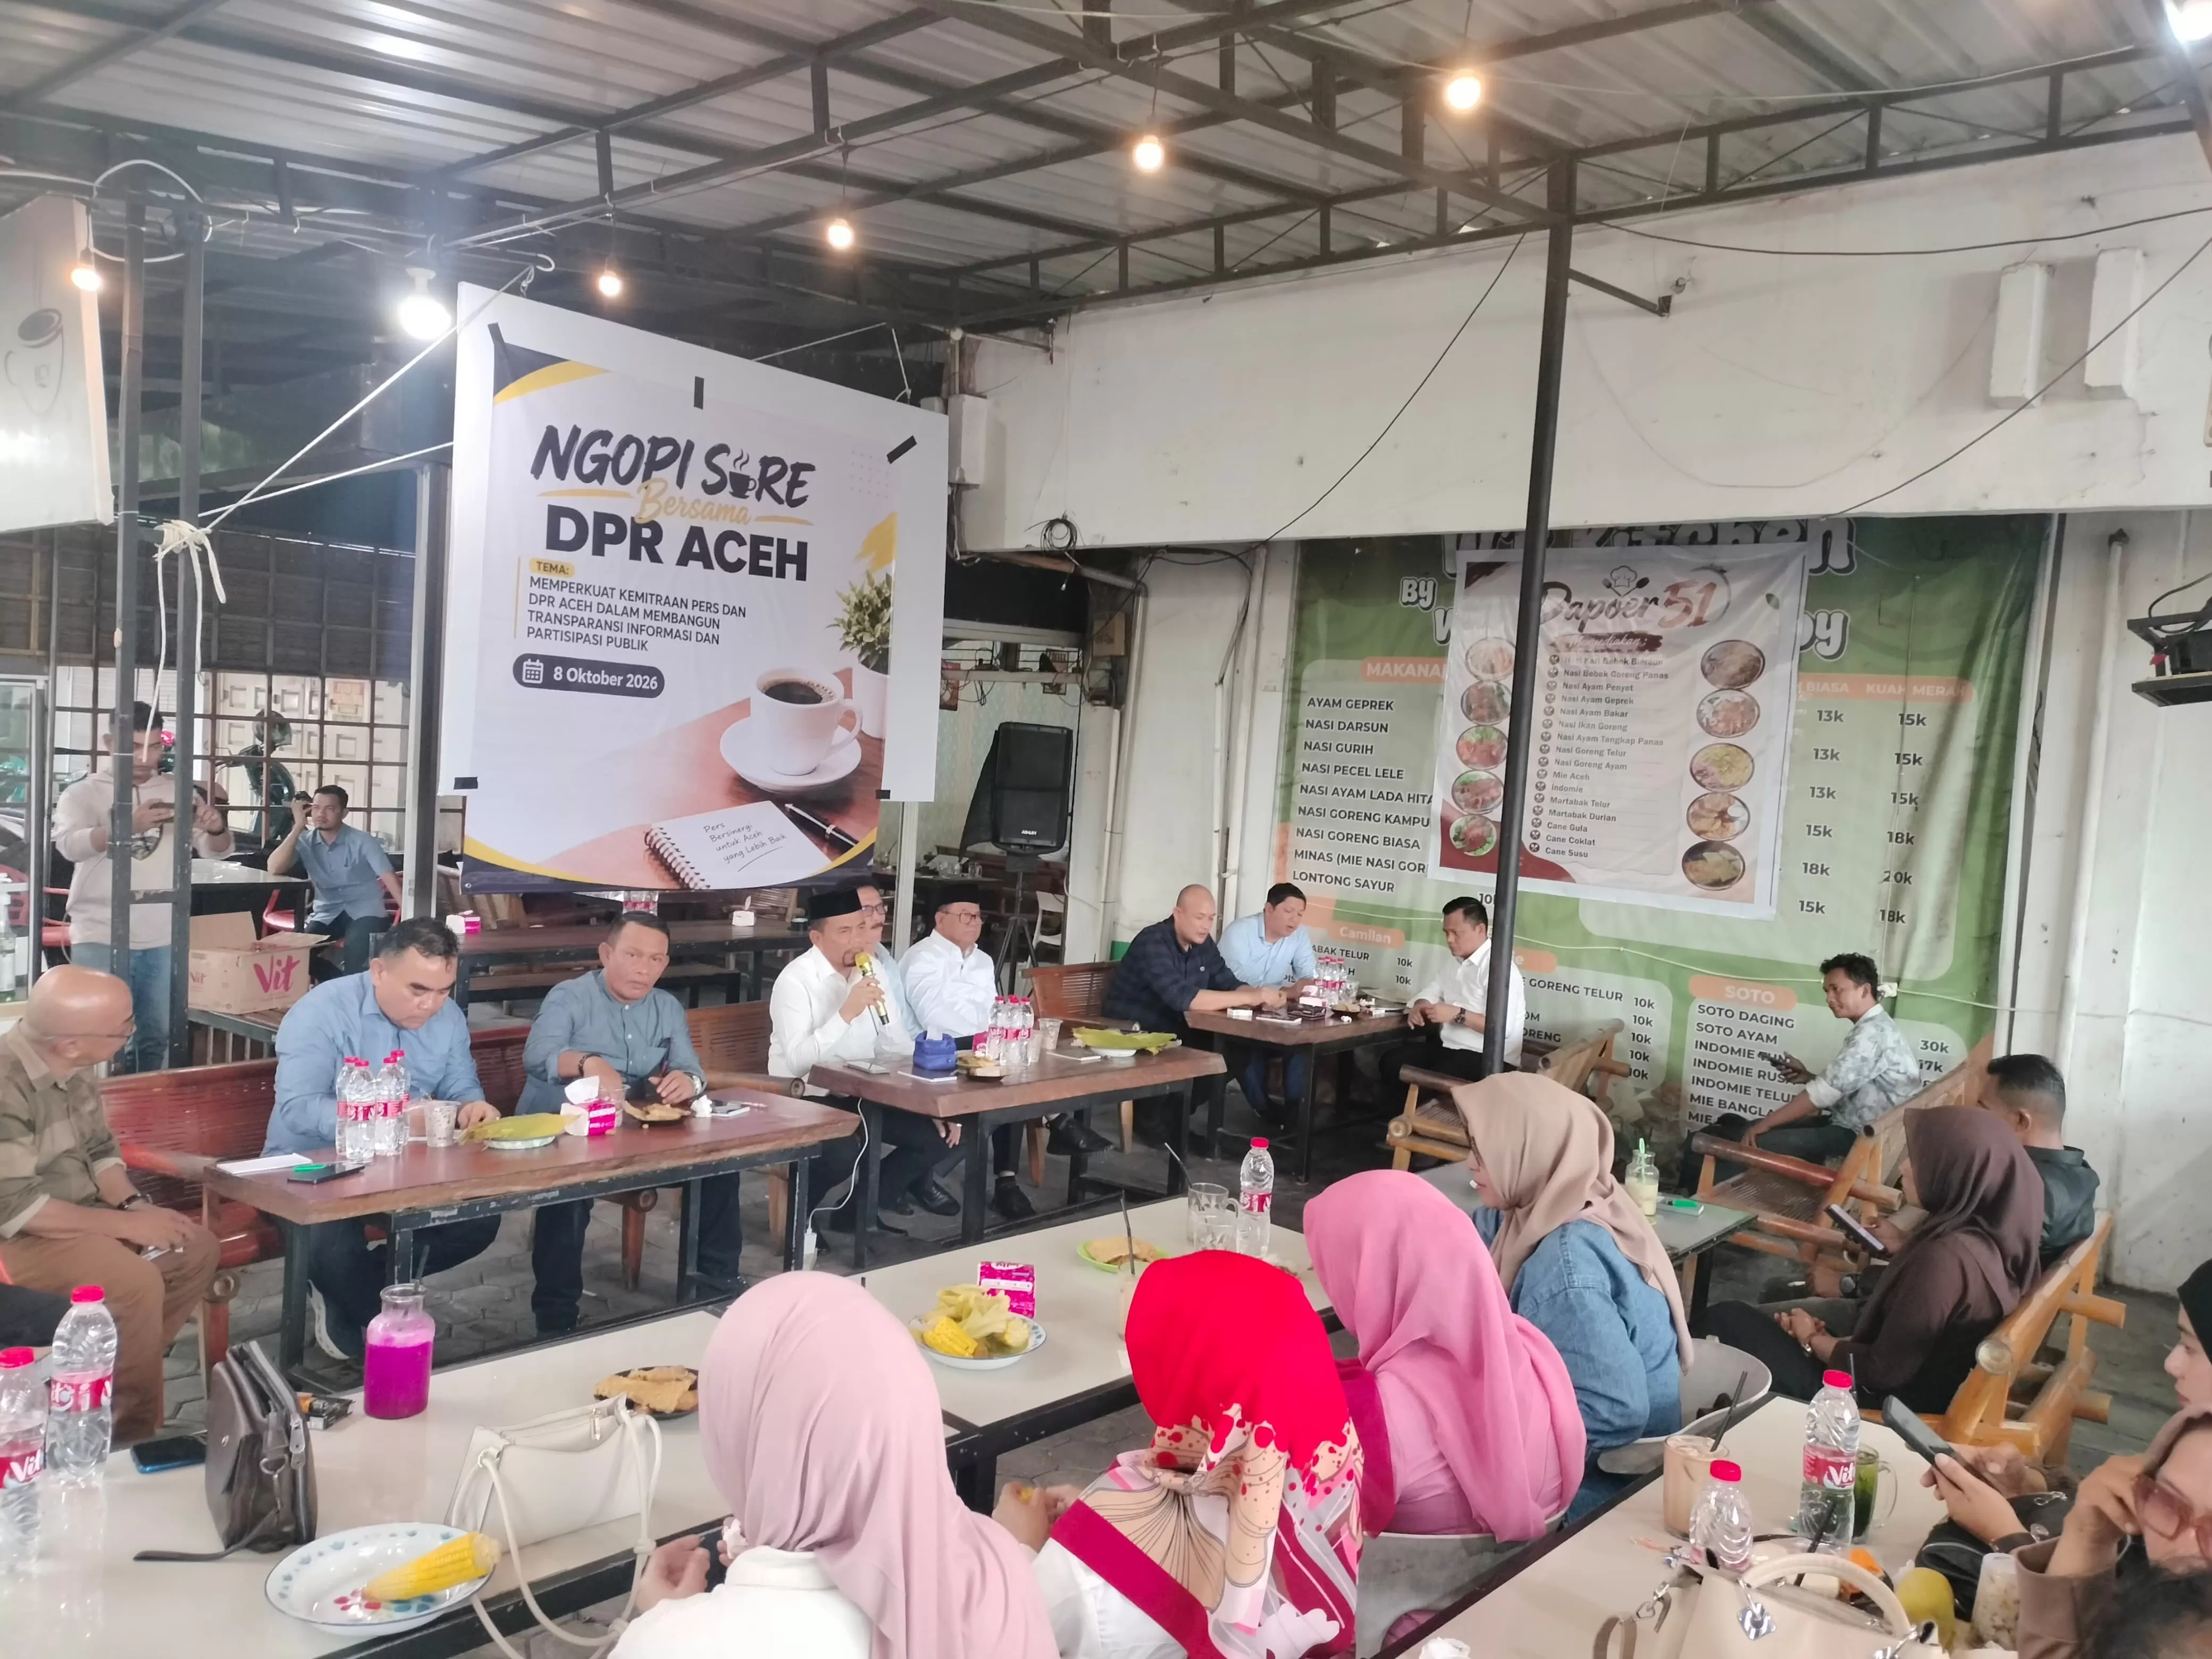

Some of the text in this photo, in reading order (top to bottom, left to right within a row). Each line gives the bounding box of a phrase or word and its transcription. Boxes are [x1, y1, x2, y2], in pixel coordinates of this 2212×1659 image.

[530, 424, 693, 490] NGOPI
[635, 477, 752, 525] Bersama
[546, 504, 808, 582] DPR ACEH
[537, 561, 569, 575] TEMA:
[530, 576, 746, 618] MEMPERKUAT KEMITRAAN PERS DAN
[1658, 579, 1717, 628] 51
[529, 593, 720, 629] DPR ACEH DALAM MEMBANGUN
[527, 610, 719, 644] TRANSPARANSI INFORMASI DAN
[527, 626, 648, 651] PARTISIPASI PUBLIK
[553, 666, 658, 690] 8 Oktober 2026
[1611, 671, 1640, 680] Goreng
[1582, 683, 1604, 691] Ayam
[1606, 683, 1633, 692] Penyet
[1806, 681, 1849, 693] BIASA
[1581, 696, 1602, 704] Ayam
[1605, 697, 1634, 706] Geprek
[1307, 698, 1927, 726] AYAM GEPREK 13k 15k
[1579, 709, 1601, 717] Ayam
[1598, 723, 1628, 732] Goreng
[1305, 719, 1923, 767] NASI DARSUN 13k 15k
[1577, 734, 1598, 743] Ayam
[1601, 735, 1635, 745] Tangkap
[1575, 748, 1604, 757] Goreng
[1303, 741, 1918, 806] NASI GURIH 13k 15k
[1574, 760, 1603, 770] Goreng
[1605, 762, 1627, 770] Ayam
[1301, 763, 1915, 845] NASI PECEL LELE 15k 18k
[1550, 797, 1610, 808] Martabak Telur
[1548, 809, 1616, 822] Martabak Durian
[703, 822, 725, 833] Pers
[709, 823, 753, 843] Bersinergi
[1300, 784, 1328, 795] NASI
[1331, 786, 1367, 799] AYAM
[1370, 789, 1404, 801] LADA
[1407, 793, 1433, 805] HITA
[1802, 862, 1830, 876] 18k
[716, 832, 763, 851] untuk Aceh
[1296, 827, 1421, 850] NASI GORENG BIASA
[1569, 836, 1596, 846] Coklat
[724, 833, 787, 864] yang Lebih Baik
[1545, 847, 1588, 858] Cane Susu
[1294, 849, 1428, 874] MINAS (MIE NASI GOR
[1298, 806, 1906, 924] NASI GORENG KAMPU 15k 18k
[1293, 870, 1495, 904] LONTONG SAYUR 10
[1339, 926, 1392, 944] Camilan
[1339, 949, 1370, 960] TELUR
[1397, 958, 1413, 967] 10k
[190, 971, 207, 984] Vit
[253, 955, 300, 993] Vit
[1396, 975, 1411, 985] 10k
[1529, 977, 1580, 994] GORENG
[1583, 986, 1623, 1002] TELUR
[1634, 997, 1655, 1009] 10k
[1724, 985, 1775, 1004] SOTO
[1632, 1015, 1653, 1027] 10k
[1697, 1004, 1949, 1054] SOTO DAGING 30k
[1523, 1027, 1652, 1045] ORENG 10k
[1696, 1022, 1733, 1036] SOTO
[1737, 1029, 1778, 1044] AYAM
[1629, 1049, 1649, 1062] 10k
[1695, 1040, 1755, 1059] INDOMIE
[1693, 1058, 1753, 1077] INDOMIE
[1691, 1076, 1752, 1095] INDOMIE
[1690, 1094, 1773, 1117] MIE BANGLA
[1688, 1111, 1713, 1124] MIE
[10, 1448, 43, 1482] Vit
[1828, 1462, 1855, 1486] Vit
